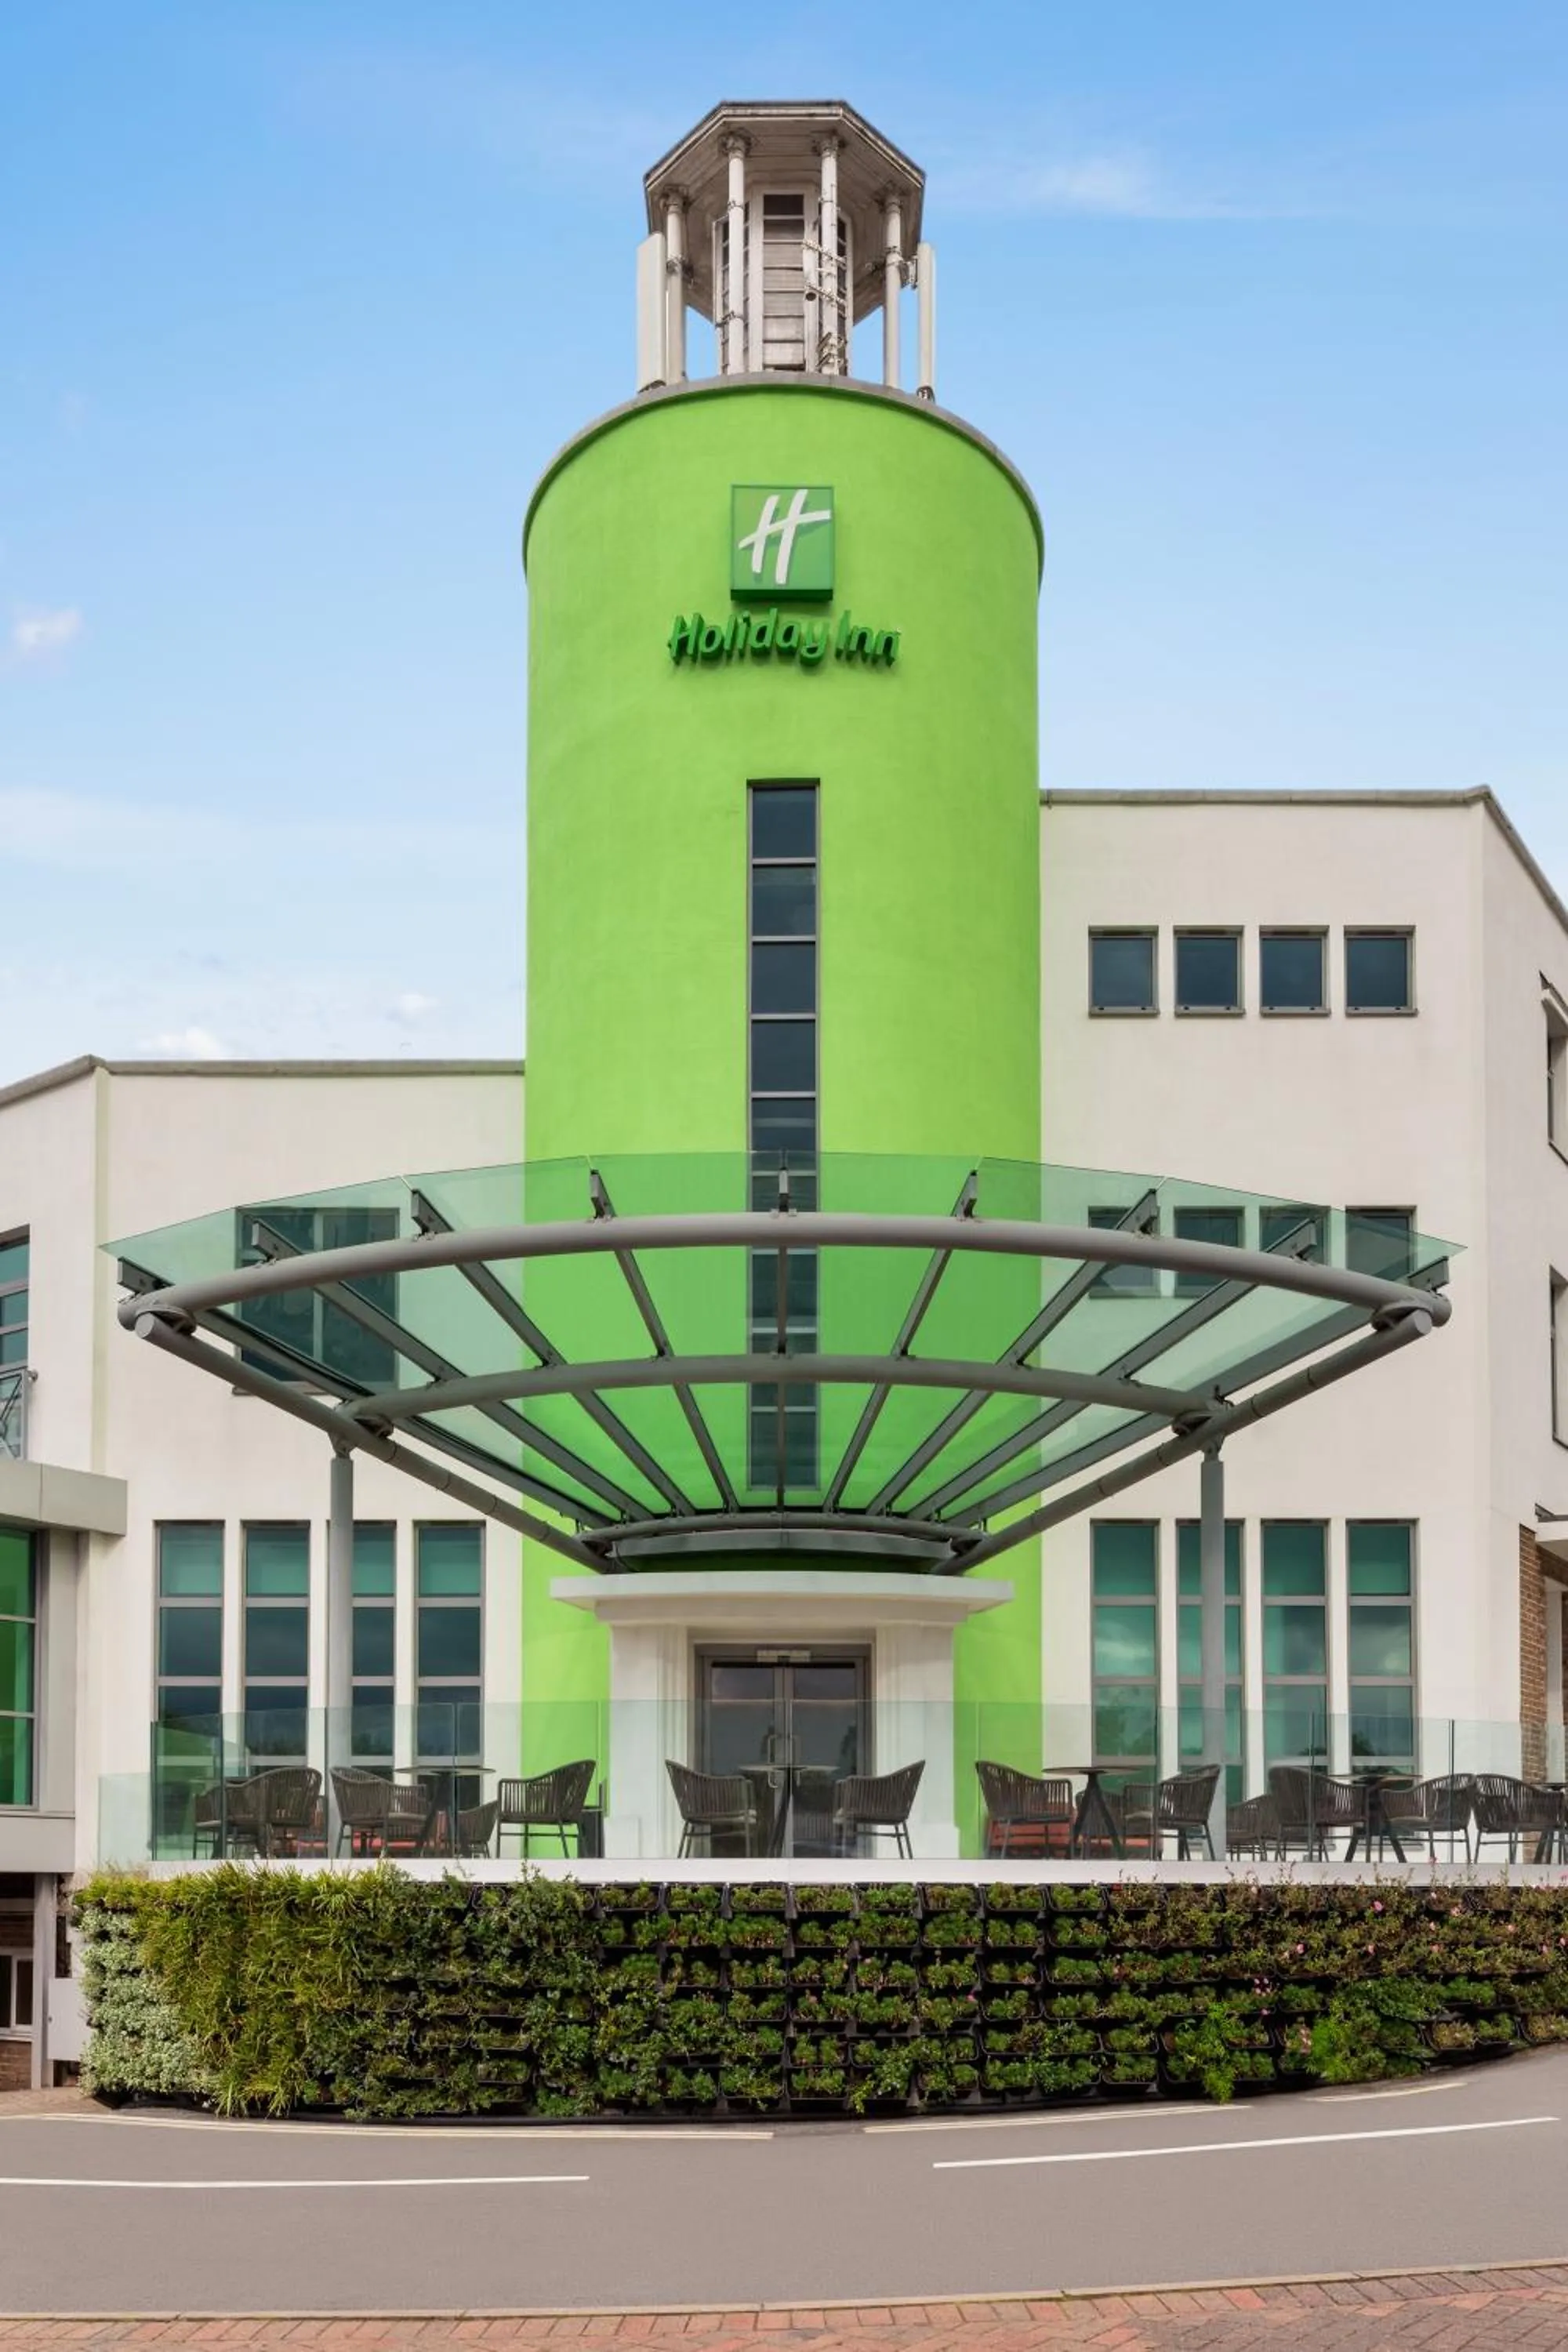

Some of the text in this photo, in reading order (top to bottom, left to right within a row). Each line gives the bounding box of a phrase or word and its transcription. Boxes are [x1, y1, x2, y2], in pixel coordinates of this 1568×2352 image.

[739, 488, 831, 585] H
[669, 608, 901, 665] Holiday Inn
